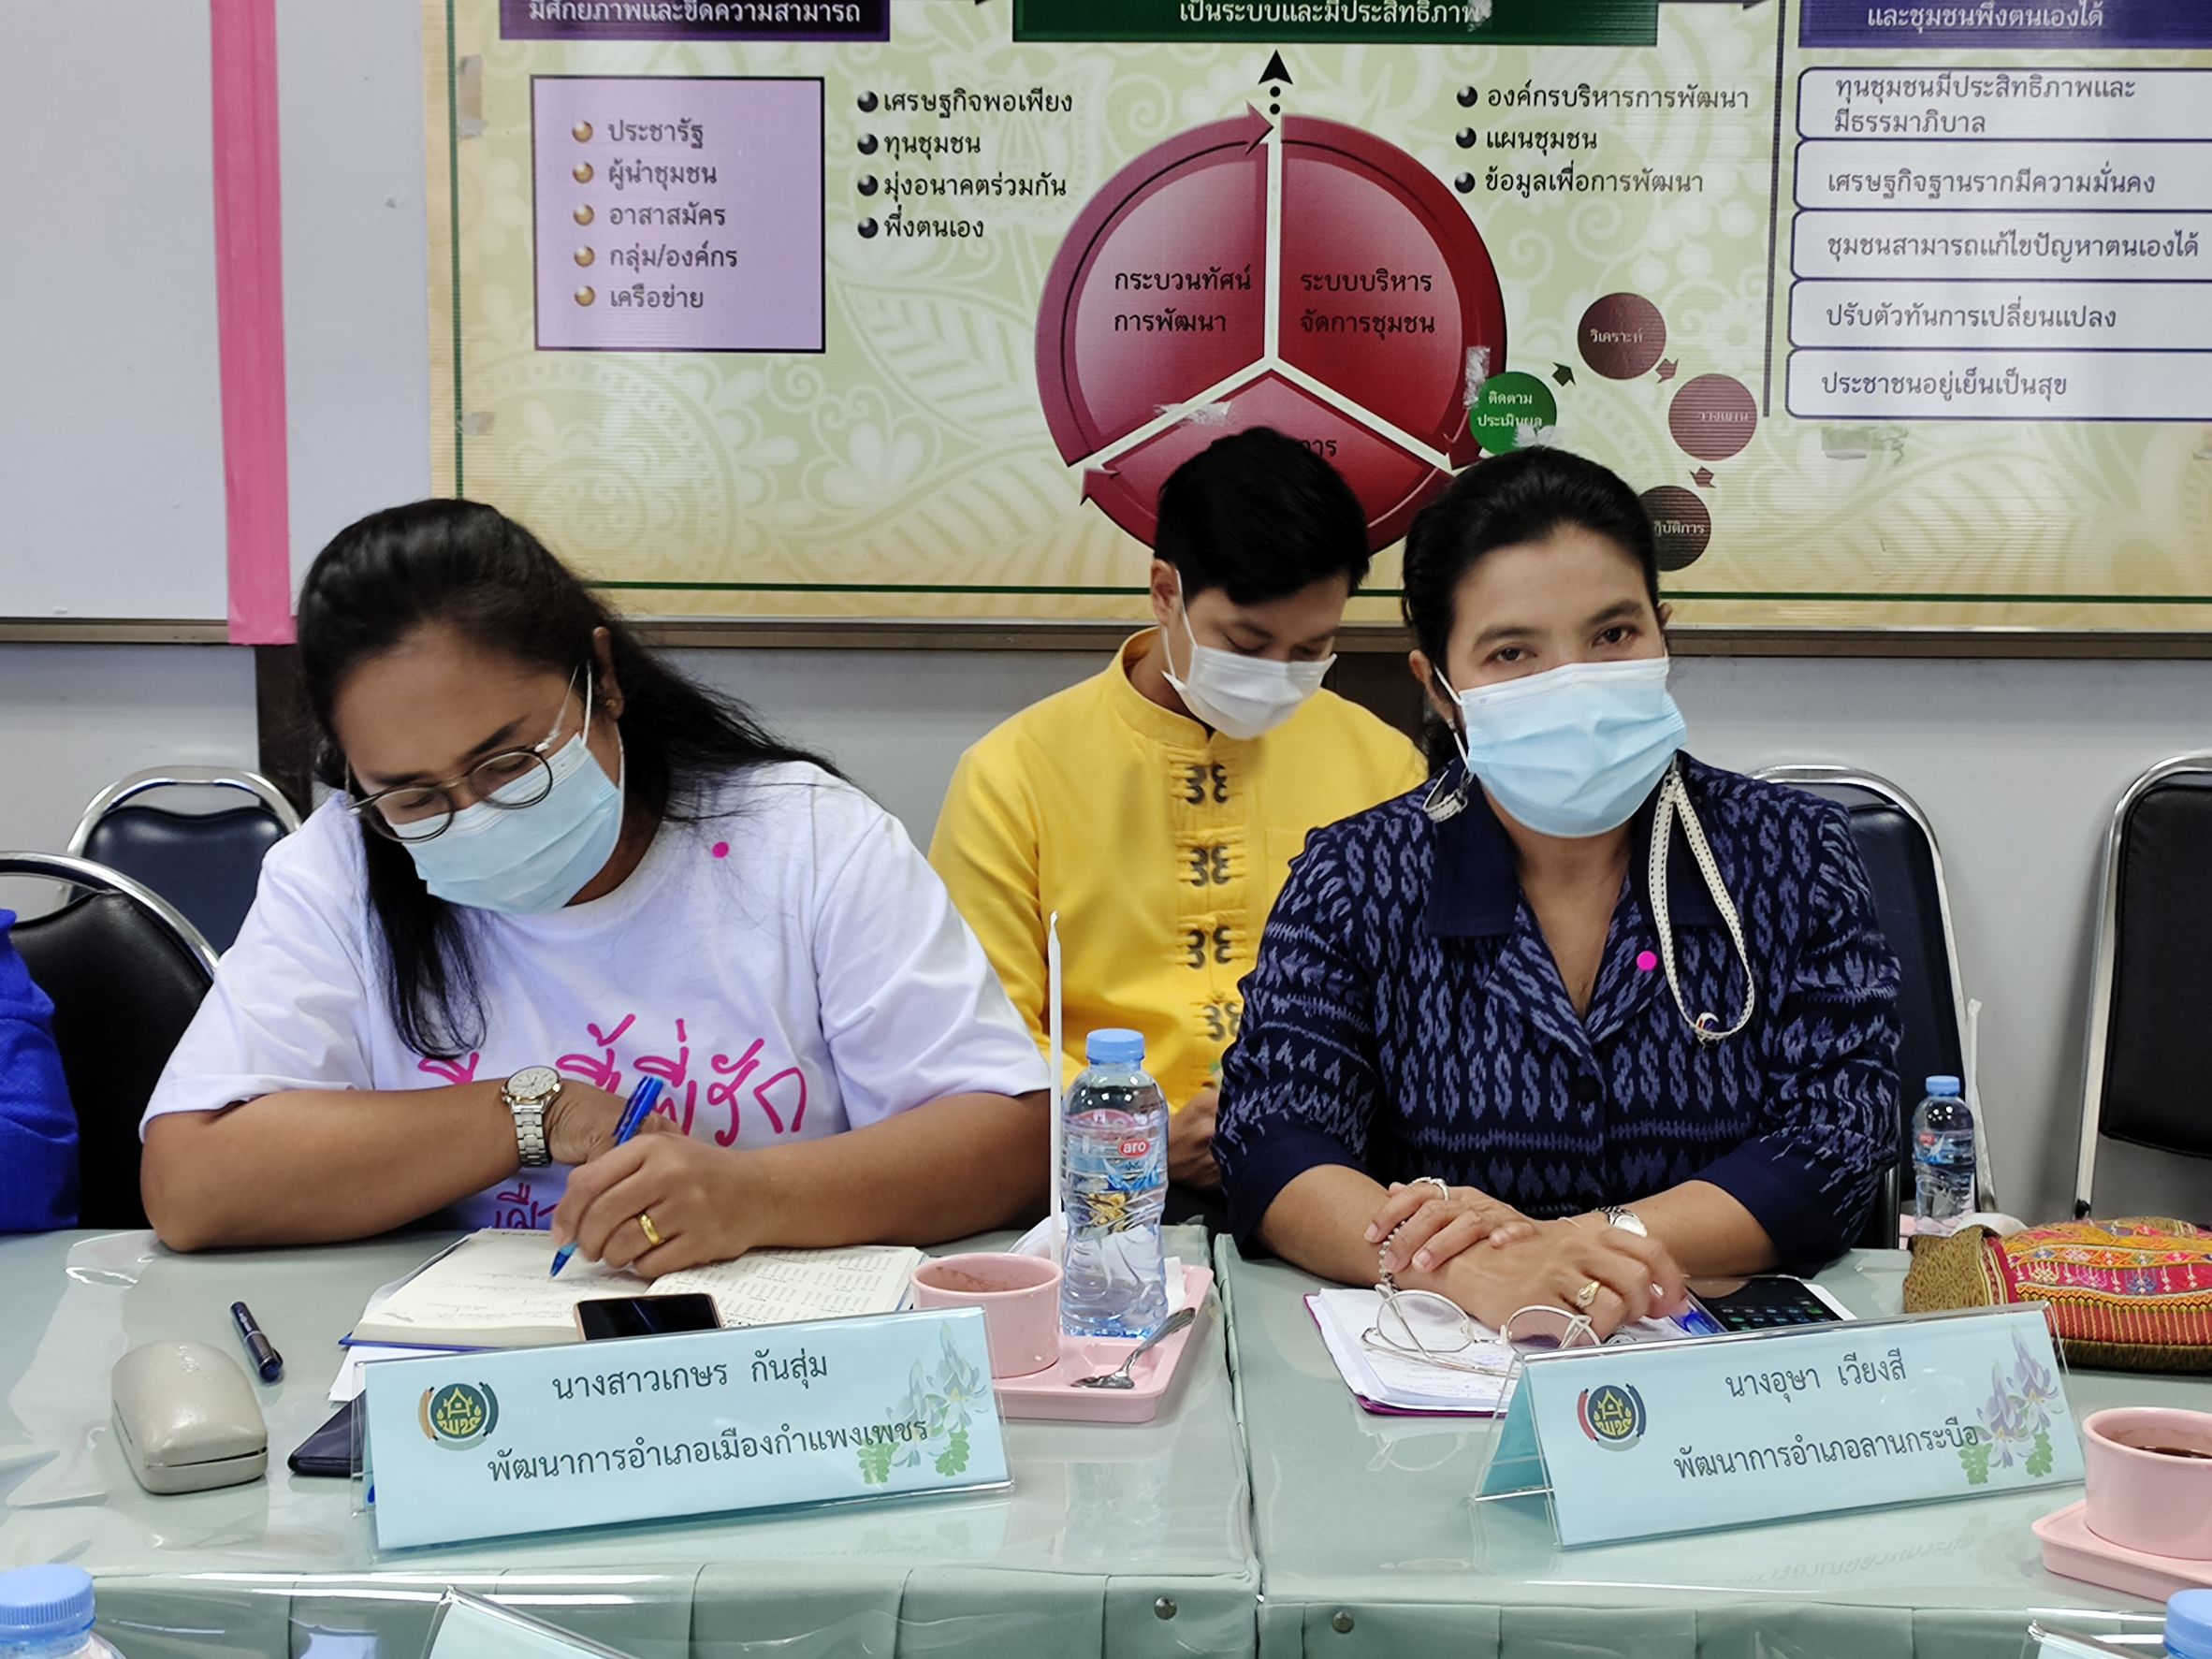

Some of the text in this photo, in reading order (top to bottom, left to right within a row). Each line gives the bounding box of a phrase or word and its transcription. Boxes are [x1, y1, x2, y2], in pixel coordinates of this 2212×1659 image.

[884, 87, 1073, 118] เศรษฐกิจพอเพียง
[1488, 80, 1749, 109] องค์กรบริหารการพัฒนา
[1836, 73, 2135, 105] ทุนชุมชนมีประสิทธิภาพและ
[608, 118, 704, 149] ประชารัฐ
[1835, 108, 1986, 133] มีธรรมาภิบาล
[884, 135, 981, 160] ทุนชุมชน
[1487, 131, 1597, 155] แผนชุมชน
[609, 158, 717, 191] ผู้นำชุมชน
[884, 171, 1066, 202] มุ่งอนาคตร่วมกัน
[1486, 160, 1703, 198] ข้อมูลเพื่อการพัฒนา
[1828, 161, 2155, 198] เศรษฐกิจฐานรากมีความมั่นคง
[610, 202, 725, 226] อาสาสมัคร
[884, 204, 983, 237] พึ่งตนเอง
[610, 240, 737, 273] กลุ่ม/องค์กร
[1827, 228, 2199, 263] ชุมชนสามารถแก้ไขปัญหาตนเองได้
[1114, 264, 1251, 291] กระบวนทัศน์
[1301, 268, 1433, 292] ระบบบริหาร
[610, 284, 704, 308] เครือข่าย
[1114, 308, 1227, 332] การพัฒนา
[1301, 310, 1435, 340] จัดการชุมชน
[1826, 297, 2117, 328] ปรับตัวทันการเปลี่ยนแปลง
[1488, 389, 1533, 404] ติดตาม
[1821, 367, 2067, 401] ประชาชนอยู่เย็นเป็นสุข
[1123, 1141, 1147, 1154] aro
[552, 1348, 828, 1400] นางสาวเกษร กันสุ่ม
[1725, 1347, 1907, 1403] นางอุษา เวียงสี
[488, 1419, 928, 1482] พัฒนาการอำเภอเมืองกำแพงเพชร
[1673, 1417, 1980, 1479] พัฒนาการอำเภอลานกระบือ
